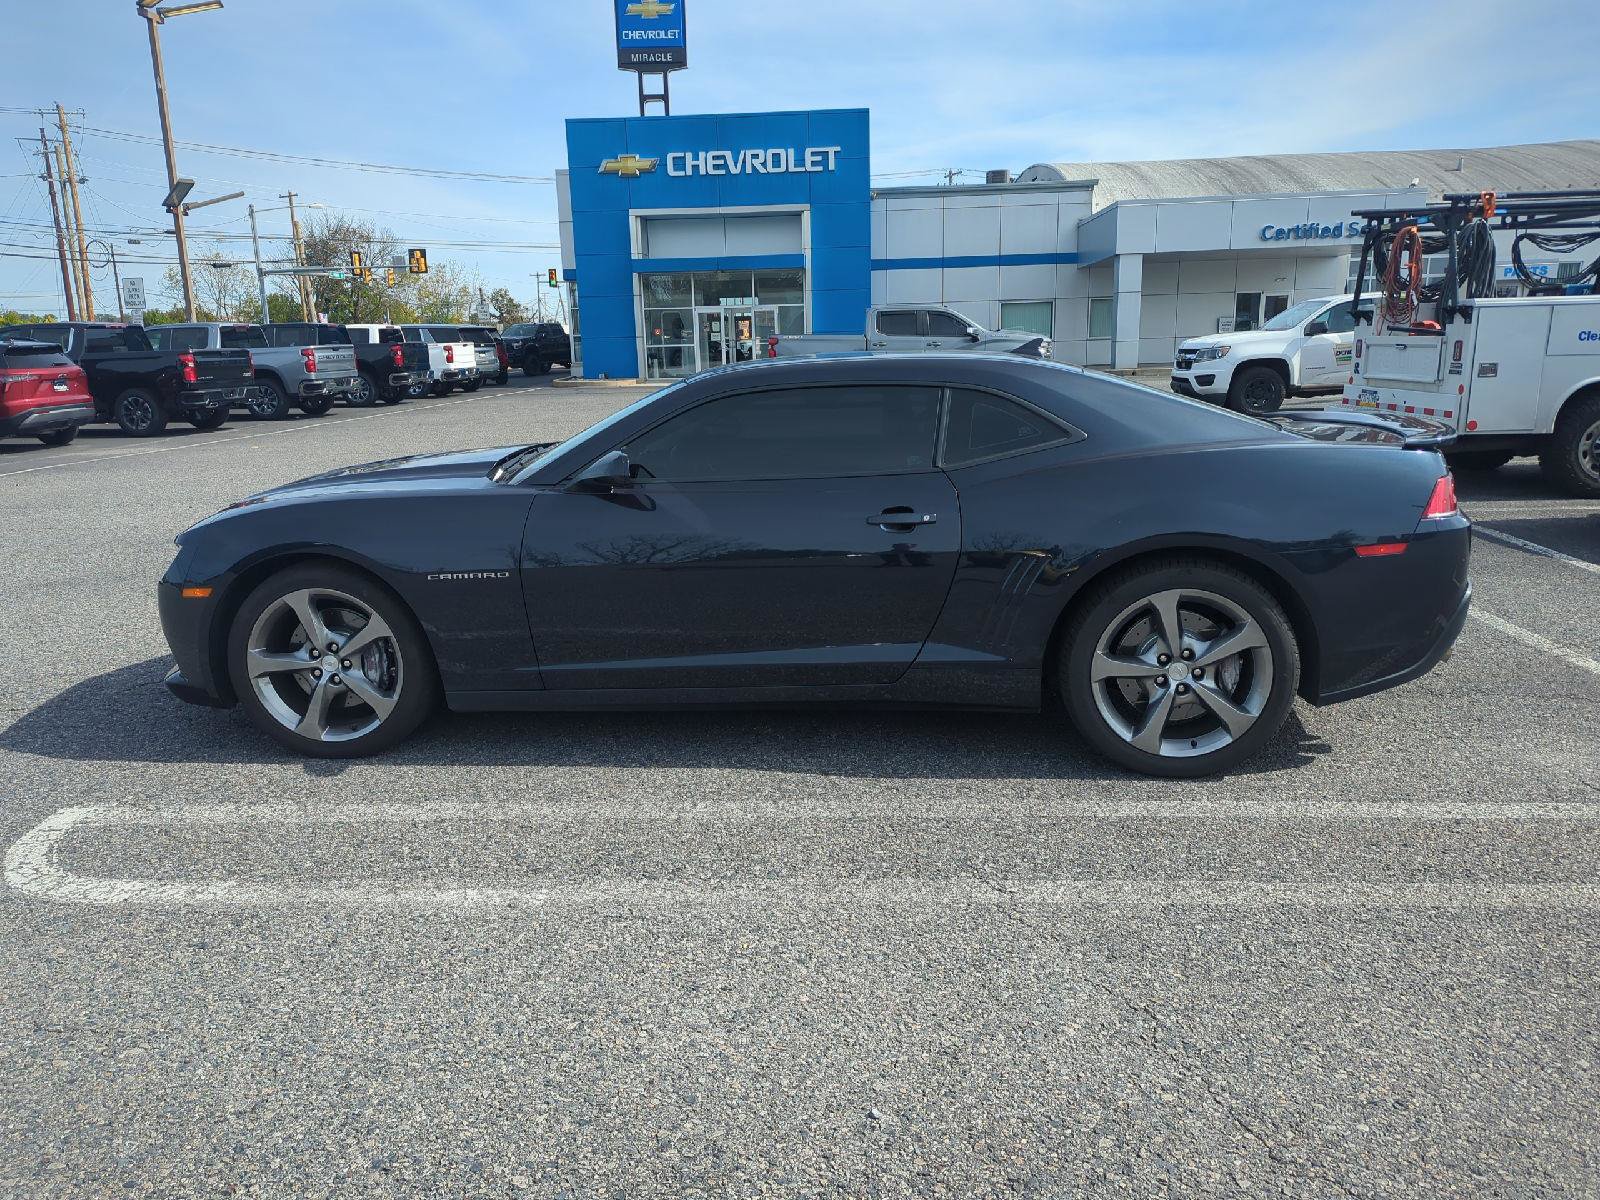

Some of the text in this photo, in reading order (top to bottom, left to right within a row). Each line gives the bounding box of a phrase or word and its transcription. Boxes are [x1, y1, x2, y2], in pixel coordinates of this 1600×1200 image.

[622, 29, 680, 40] CHEVROLET
[631, 53, 673, 62] MIRACLE
[666, 146, 841, 177] CHEVROLET
[1261, 221, 1344, 241] Certified
[1504, 265, 1549, 277] PATS
[1578, 330, 1600, 341] Cle
[427, 572, 510, 581] CAMARO
